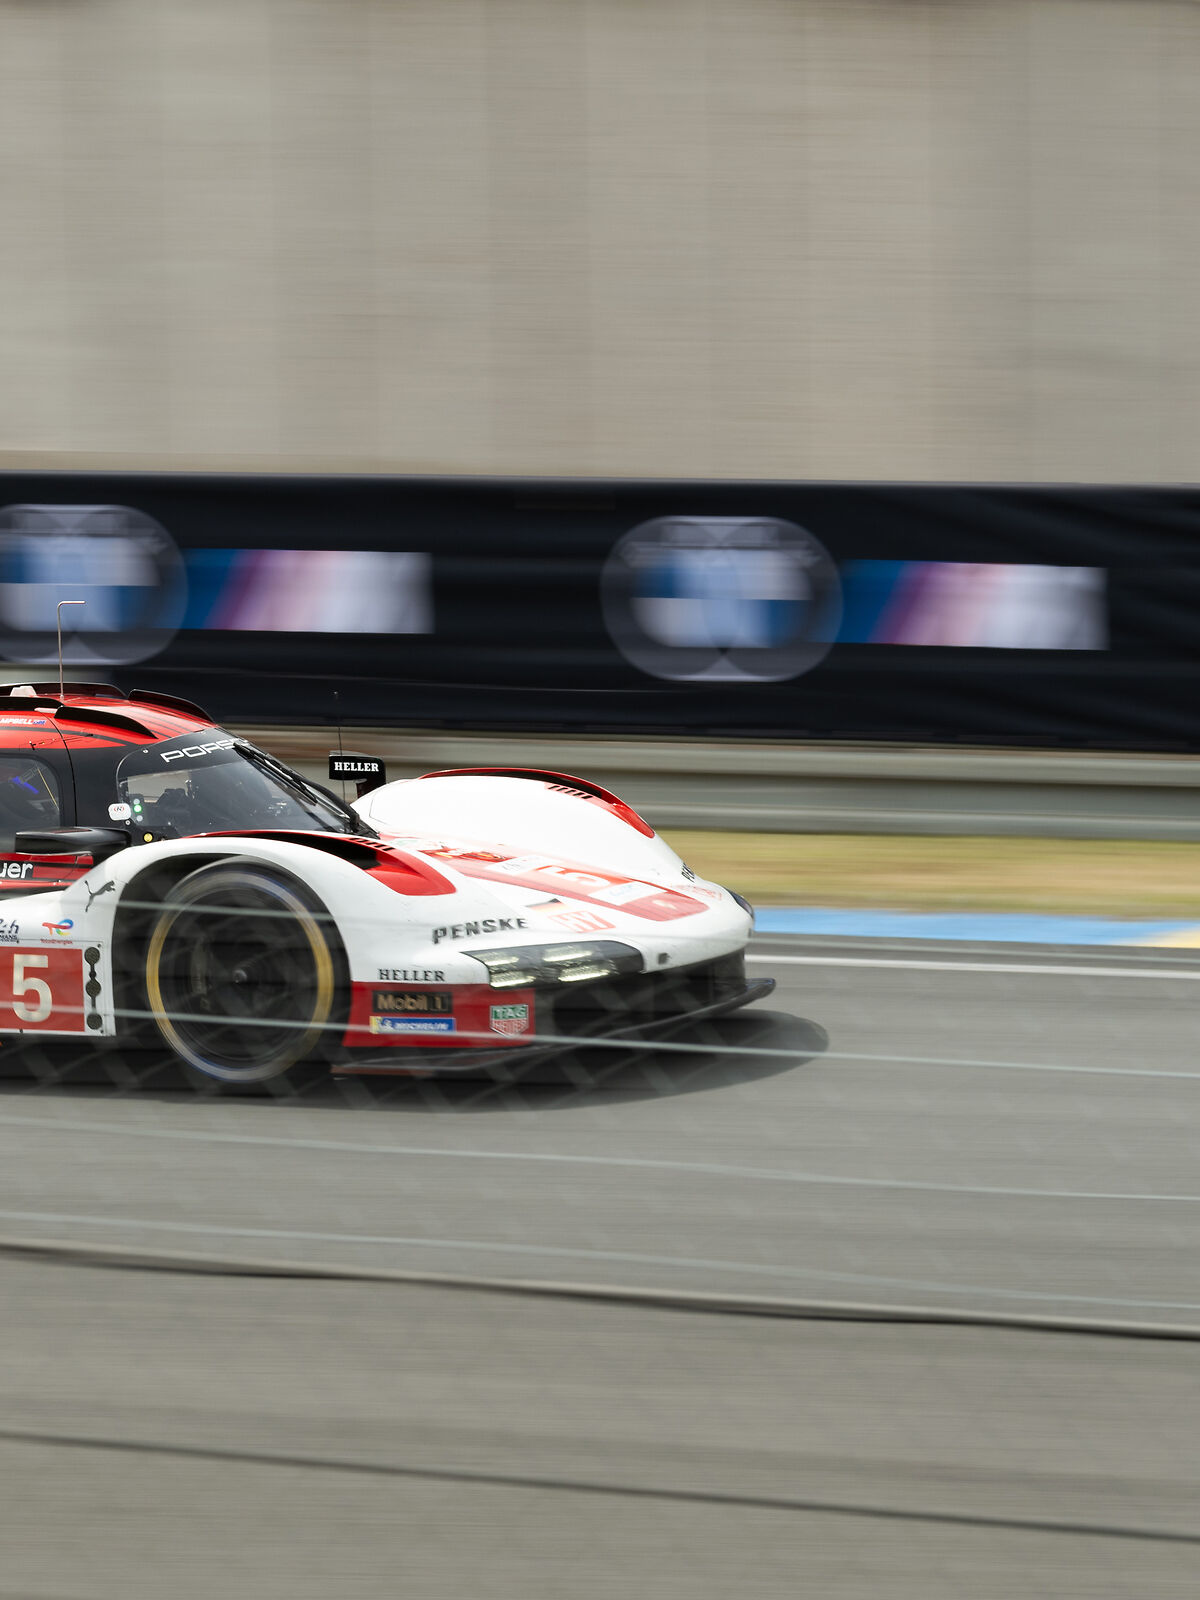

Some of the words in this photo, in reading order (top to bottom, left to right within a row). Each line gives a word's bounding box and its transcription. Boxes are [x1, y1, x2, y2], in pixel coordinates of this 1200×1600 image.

[160, 738, 249, 763] PORS
[334, 761, 379, 773] HELLER
[431, 918, 529, 945] PENSKE
[377, 968, 445, 982] HELLER
[12, 953, 53, 1023] 5
[376, 993, 428, 1011] Mobil
[495, 1005, 527, 1019] TAG
